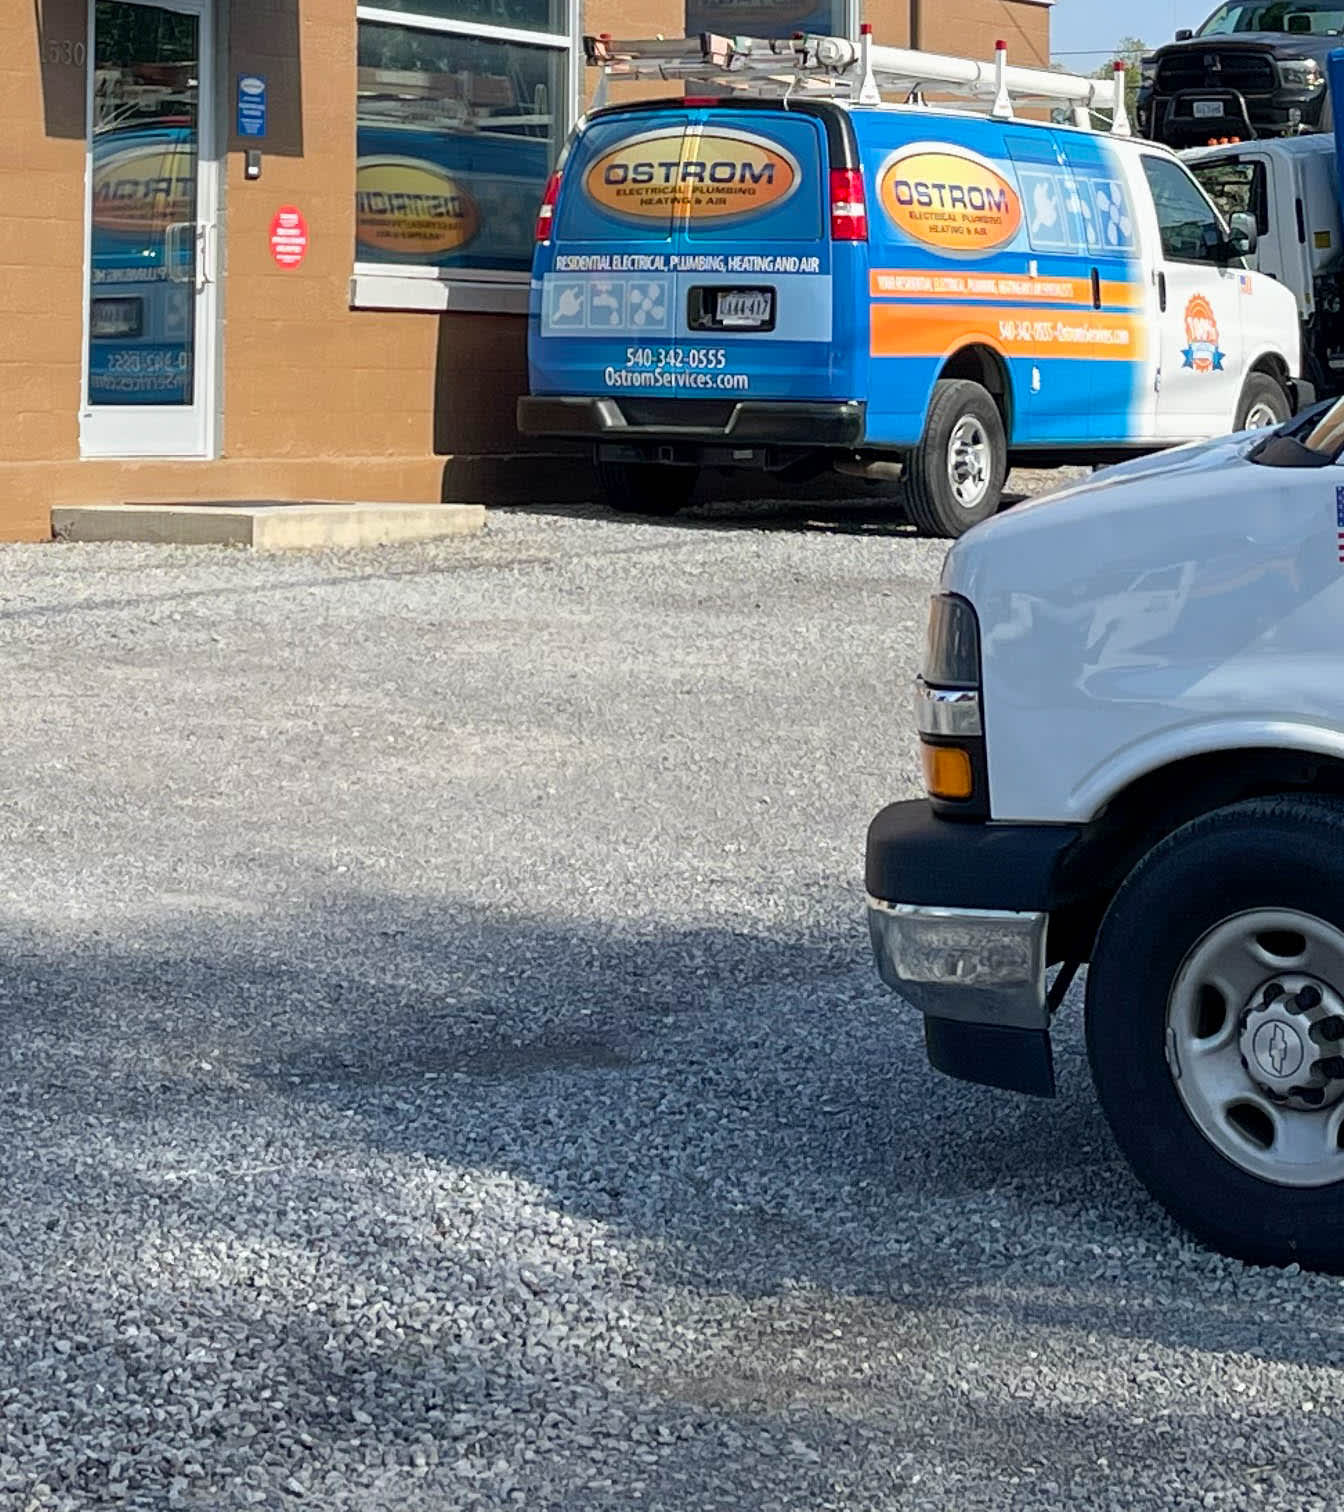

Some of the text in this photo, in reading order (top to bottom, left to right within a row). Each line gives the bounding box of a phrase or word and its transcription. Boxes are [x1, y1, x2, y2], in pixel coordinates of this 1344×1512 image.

[605, 162, 776, 185] OSTROM
[616, 187, 756, 197] ELECTRICAL PLUMBING
[640, 197, 690, 206] HEATING
[706, 197, 727, 206] AIR
[894, 180, 1009, 214] OSTROM
[556, 255, 611, 271] RESIDENTIAL
[728, 257, 773, 272] HEATING
[773, 257, 798, 272] AND
[800, 257, 819, 273] AIR
[626, 348, 726, 367] 540-342-0555
[605, 367, 749, 389] OstromServices.com
